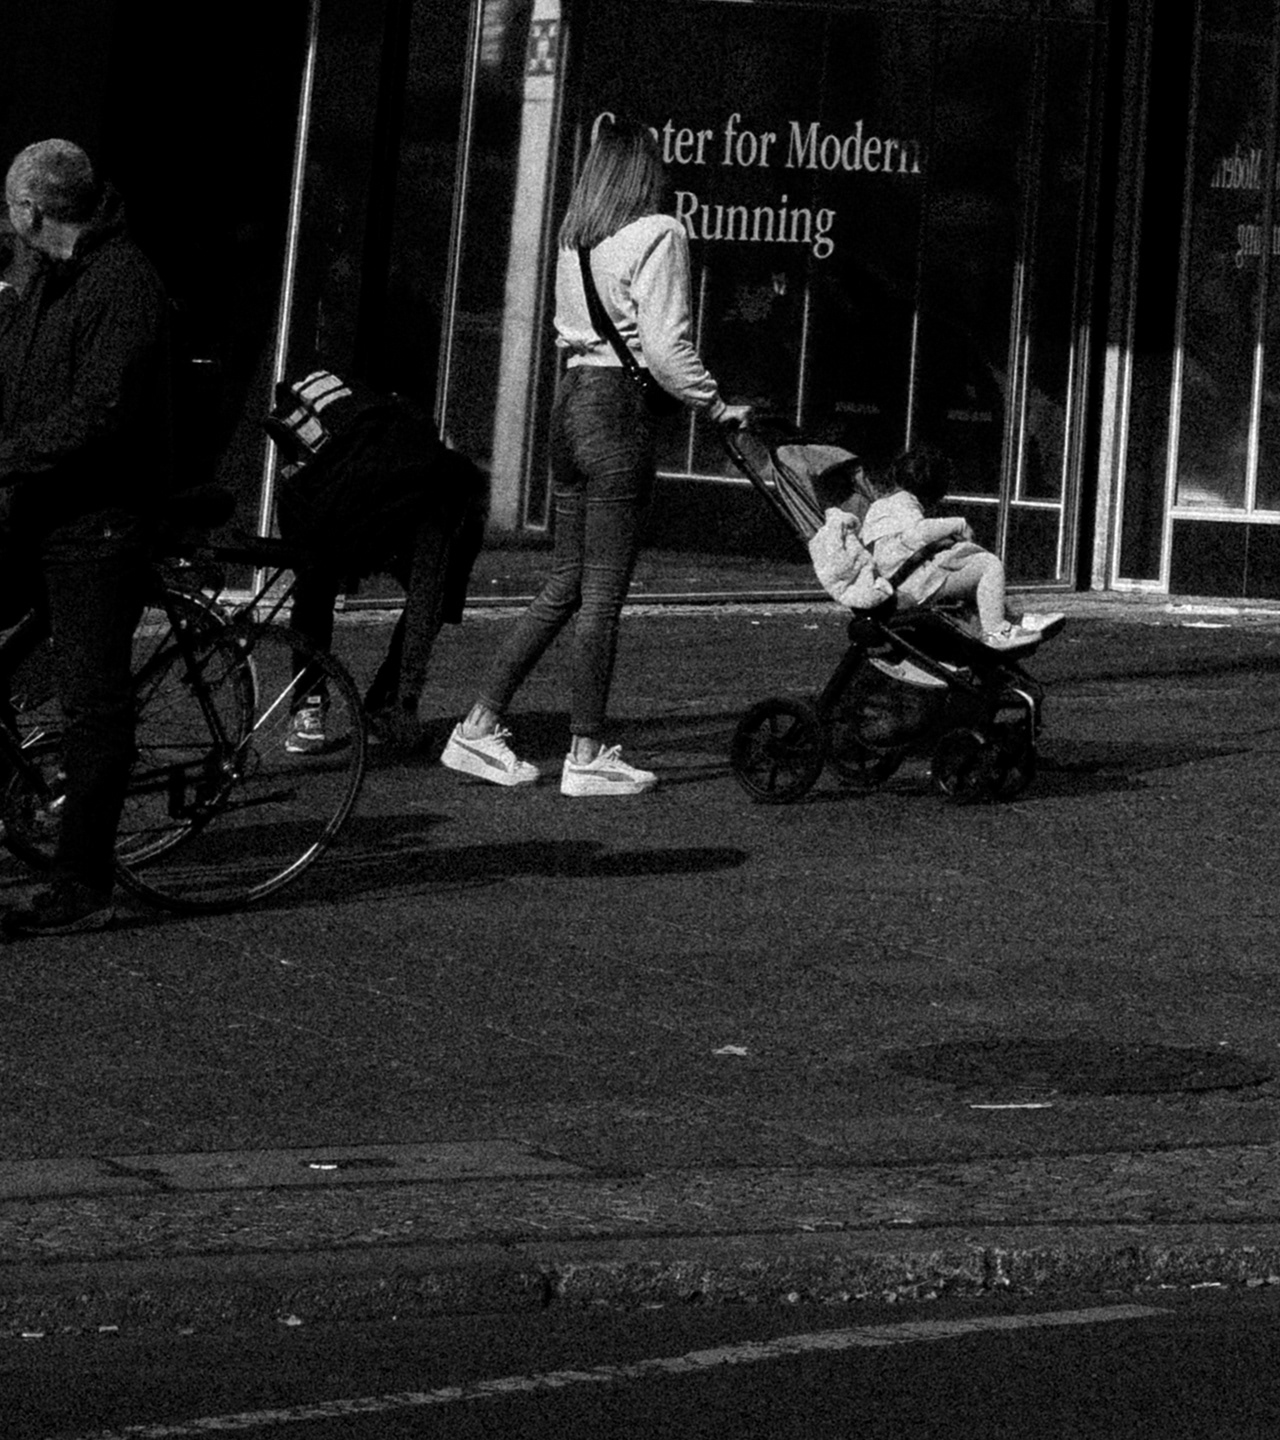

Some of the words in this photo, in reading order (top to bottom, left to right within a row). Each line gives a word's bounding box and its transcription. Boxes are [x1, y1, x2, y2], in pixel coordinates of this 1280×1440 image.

[721, 112, 777, 167] for
[785, 119, 922, 173] Modern
[674, 190, 836, 259] Running
